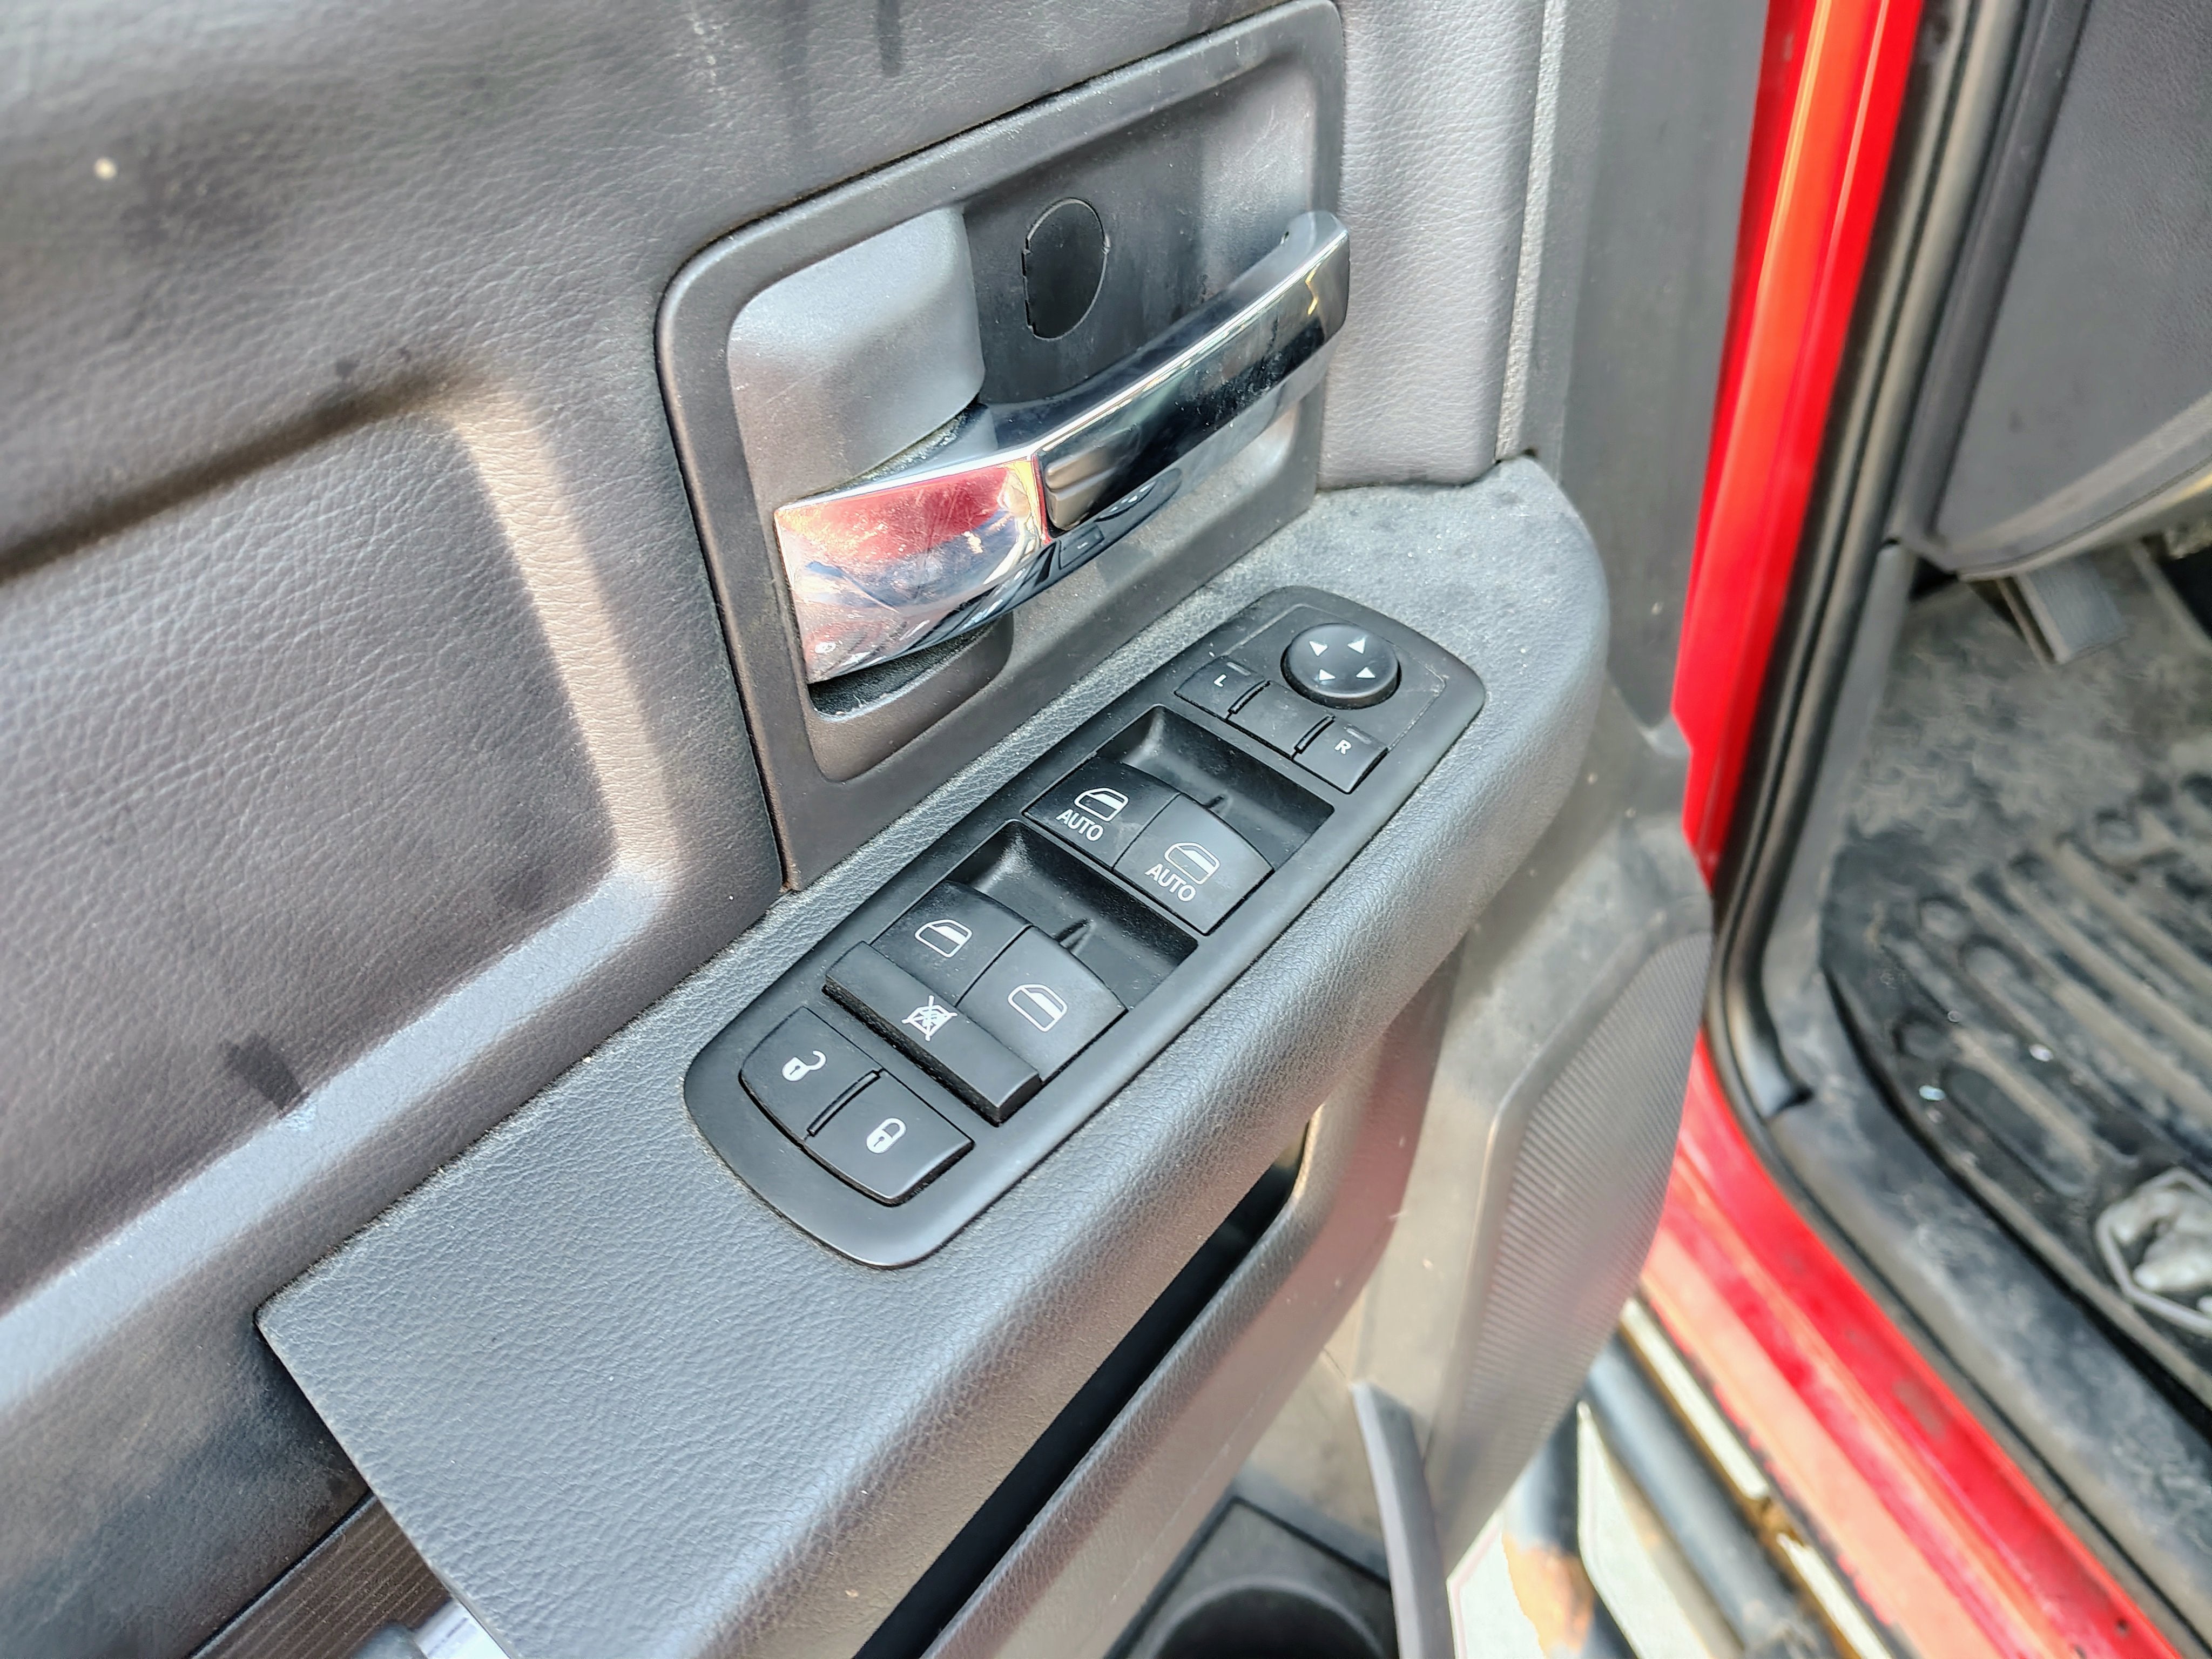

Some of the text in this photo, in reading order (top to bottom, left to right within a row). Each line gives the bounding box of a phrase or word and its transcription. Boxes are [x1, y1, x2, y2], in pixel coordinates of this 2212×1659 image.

[1213, 674, 1227, 687] L
[1334, 739, 1351, 754] R
[1056, 809, 1104, 841] AUTO
[1144, 863, 1196, 902] AUTO
